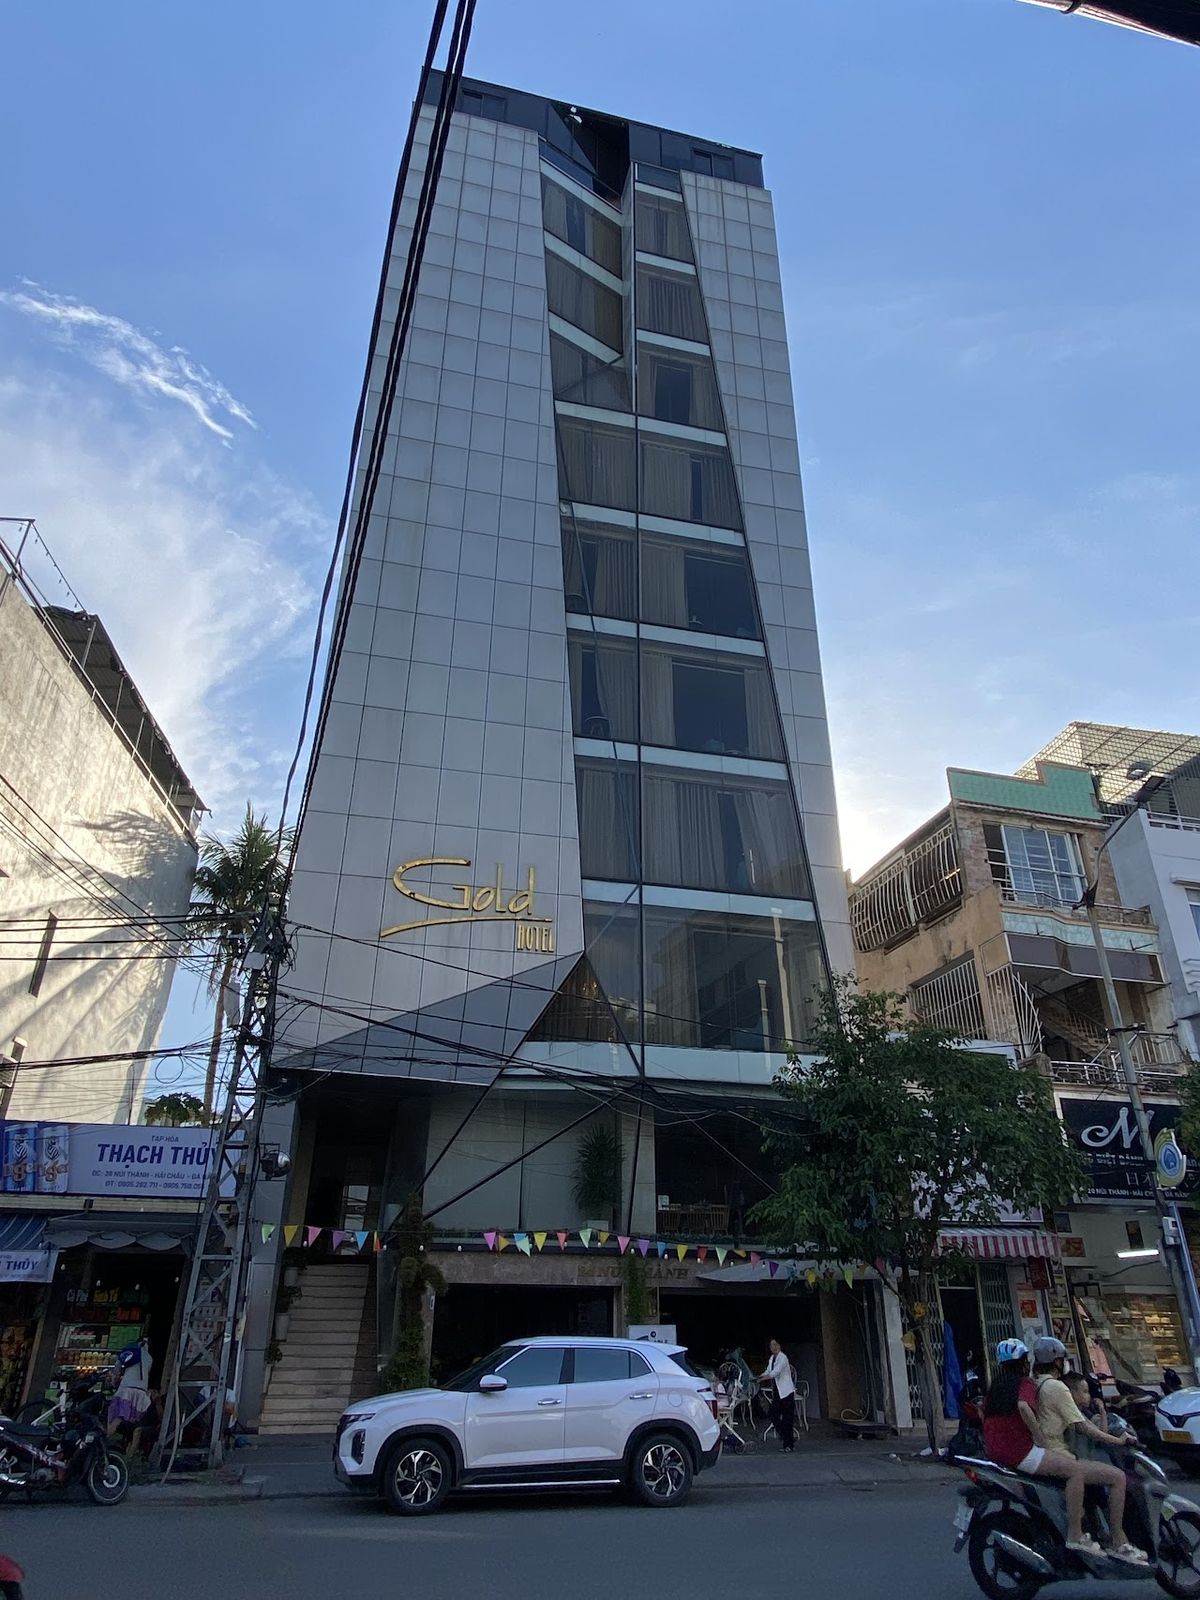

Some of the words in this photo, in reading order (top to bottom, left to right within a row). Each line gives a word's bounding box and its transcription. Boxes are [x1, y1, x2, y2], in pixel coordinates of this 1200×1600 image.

[393, 857, 535, 915] Gold
[517, 924, 554, 953] HOTEL
[97, 1143, 164, 1168] THẠCH
[7, 1258, 39, 1270] THỦY
